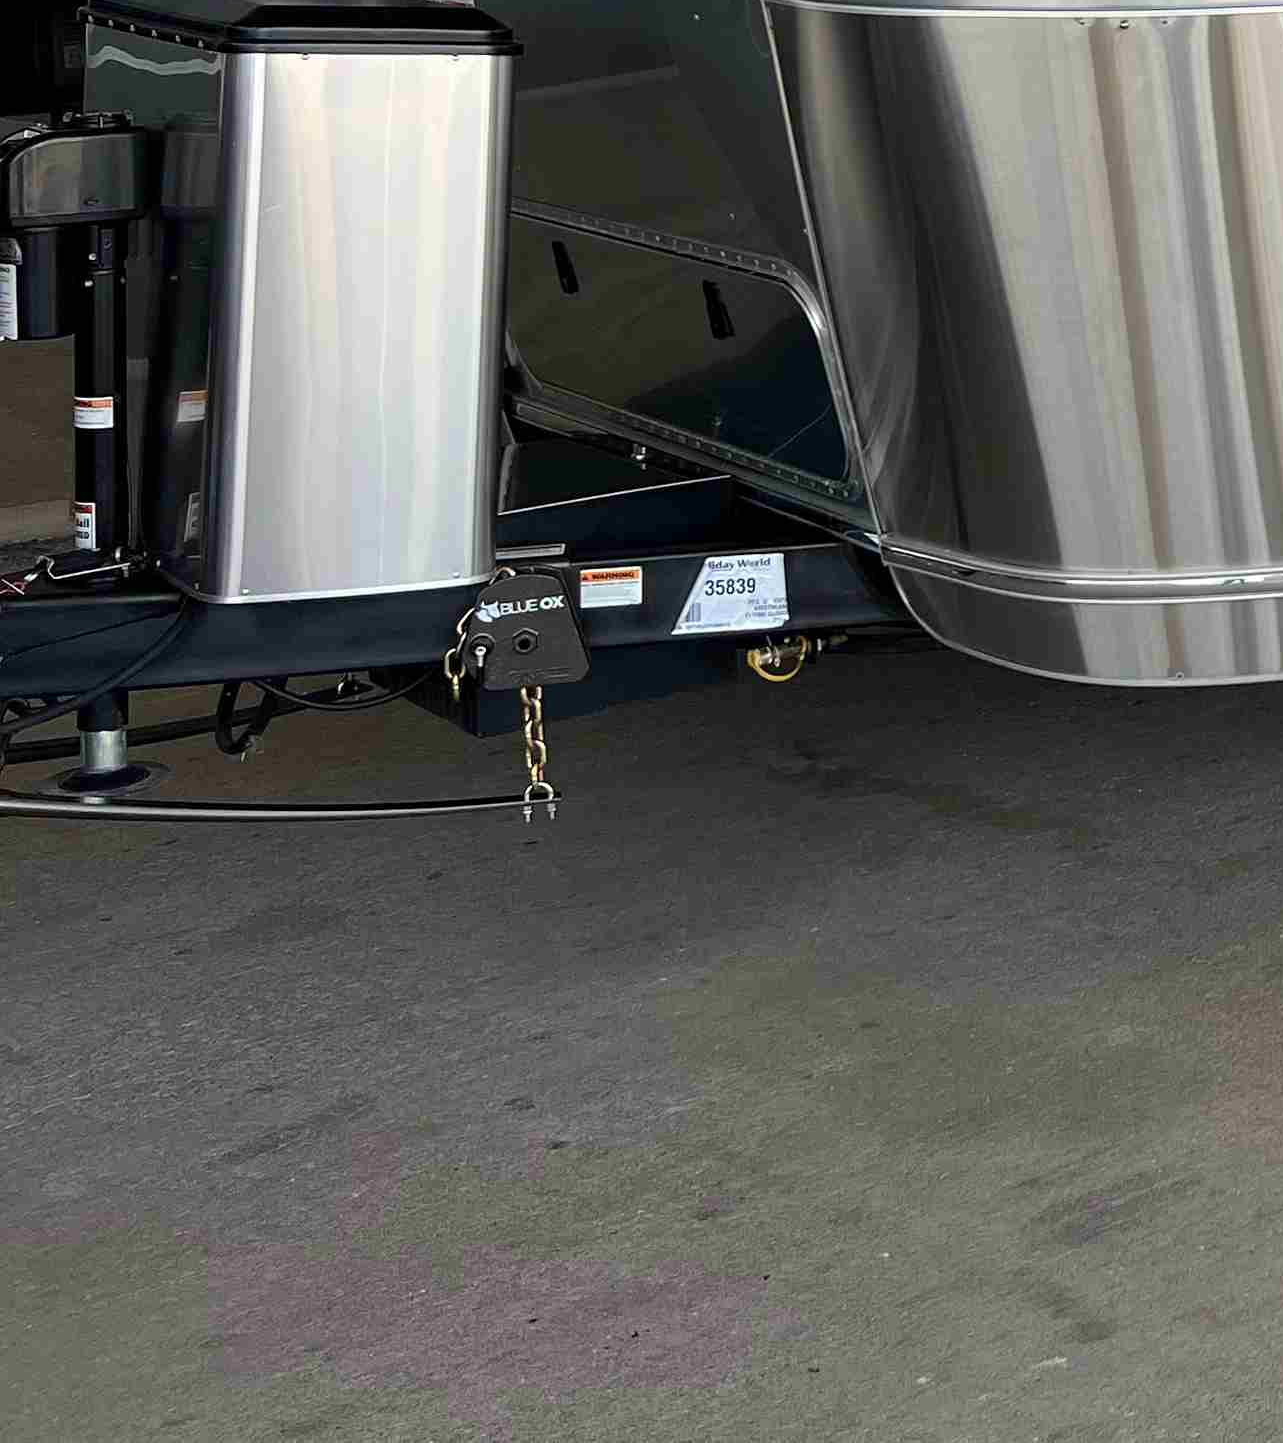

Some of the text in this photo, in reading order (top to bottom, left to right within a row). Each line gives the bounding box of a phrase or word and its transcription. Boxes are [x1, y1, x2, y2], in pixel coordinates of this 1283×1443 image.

[705, 577, 756, 596] 35839
[500, 595, 565, 616] BLUE OX
